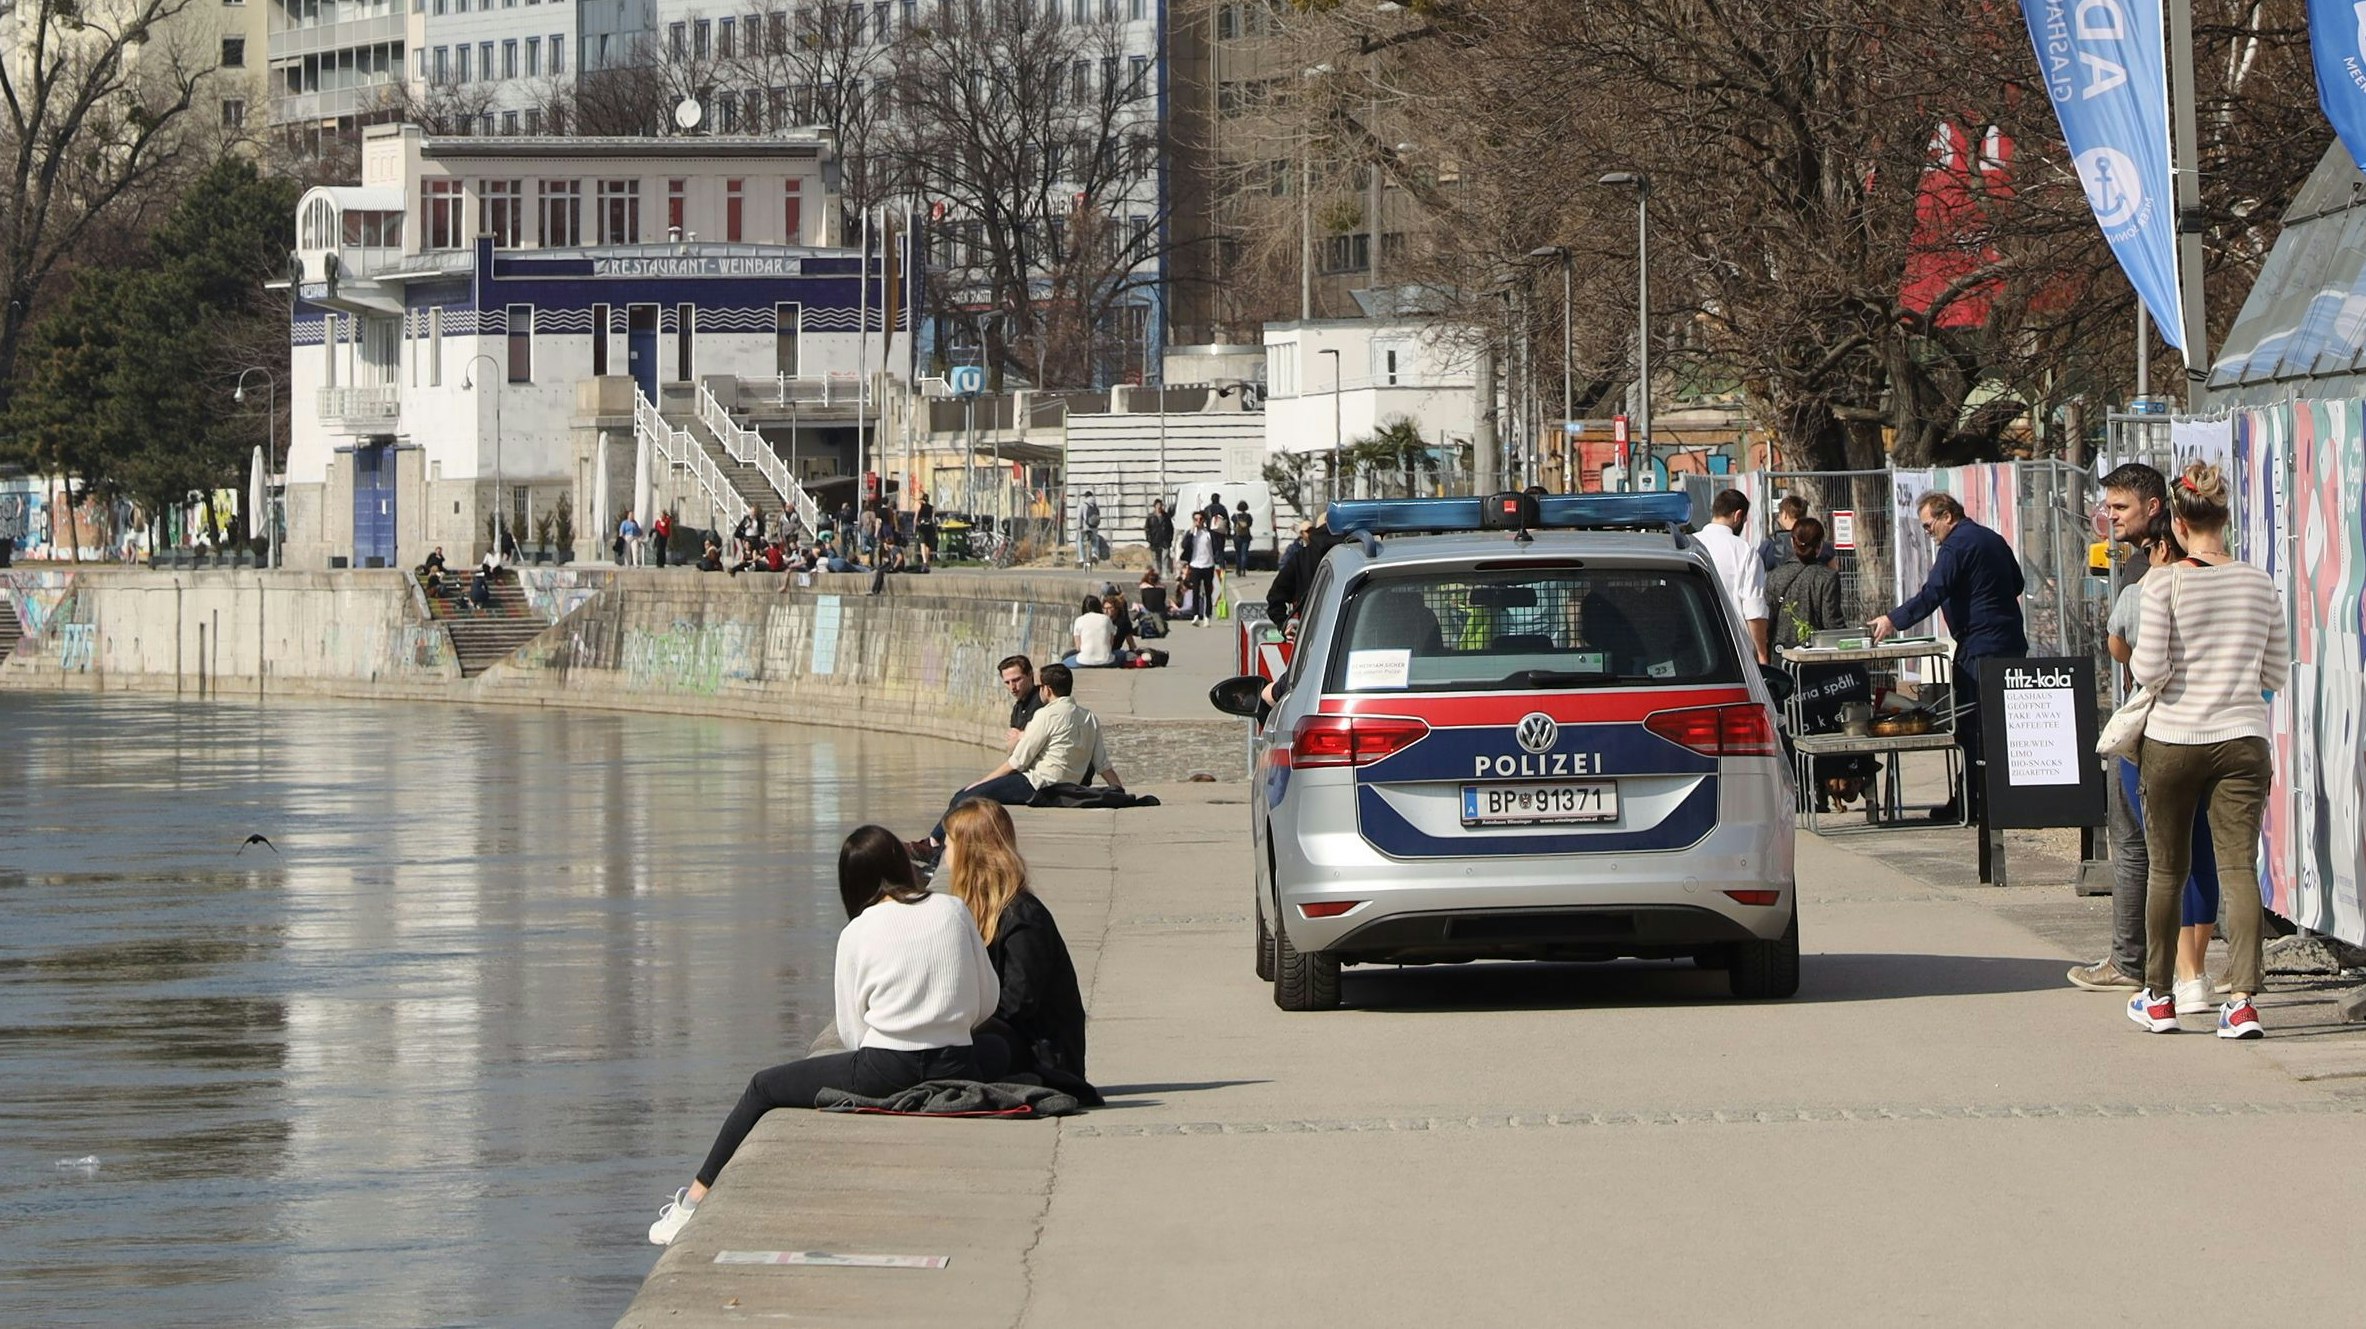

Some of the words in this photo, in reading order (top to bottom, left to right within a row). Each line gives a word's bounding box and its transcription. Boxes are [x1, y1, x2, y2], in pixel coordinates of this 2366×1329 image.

[610, 258, 707, 275] RESTAURANT
[718, 257, 783, 274] WEINBAR
[961, 371, 981, 392] U
[2004, 667, 2071, 688] fritz-kola
[2007, 692, 2053, 700] GLASHAUS
[2007, 702, 2051, 710] GEÖFFNET
[2008, 712, 2032, 720] TAKE
[2036, 711, 2061, 719] AWAY
[2010, 750, 2033, 758] LIMO
[1475, 752, 1602, 777] POLIZEI
[2011, 759, 2063, 768] BIO-SNACKS
[2012, 768, 2060, 777] ZIGARETTEN
[1489, 790, 1517, 813] BP
[1535, 788, 1602, 812] 91371
